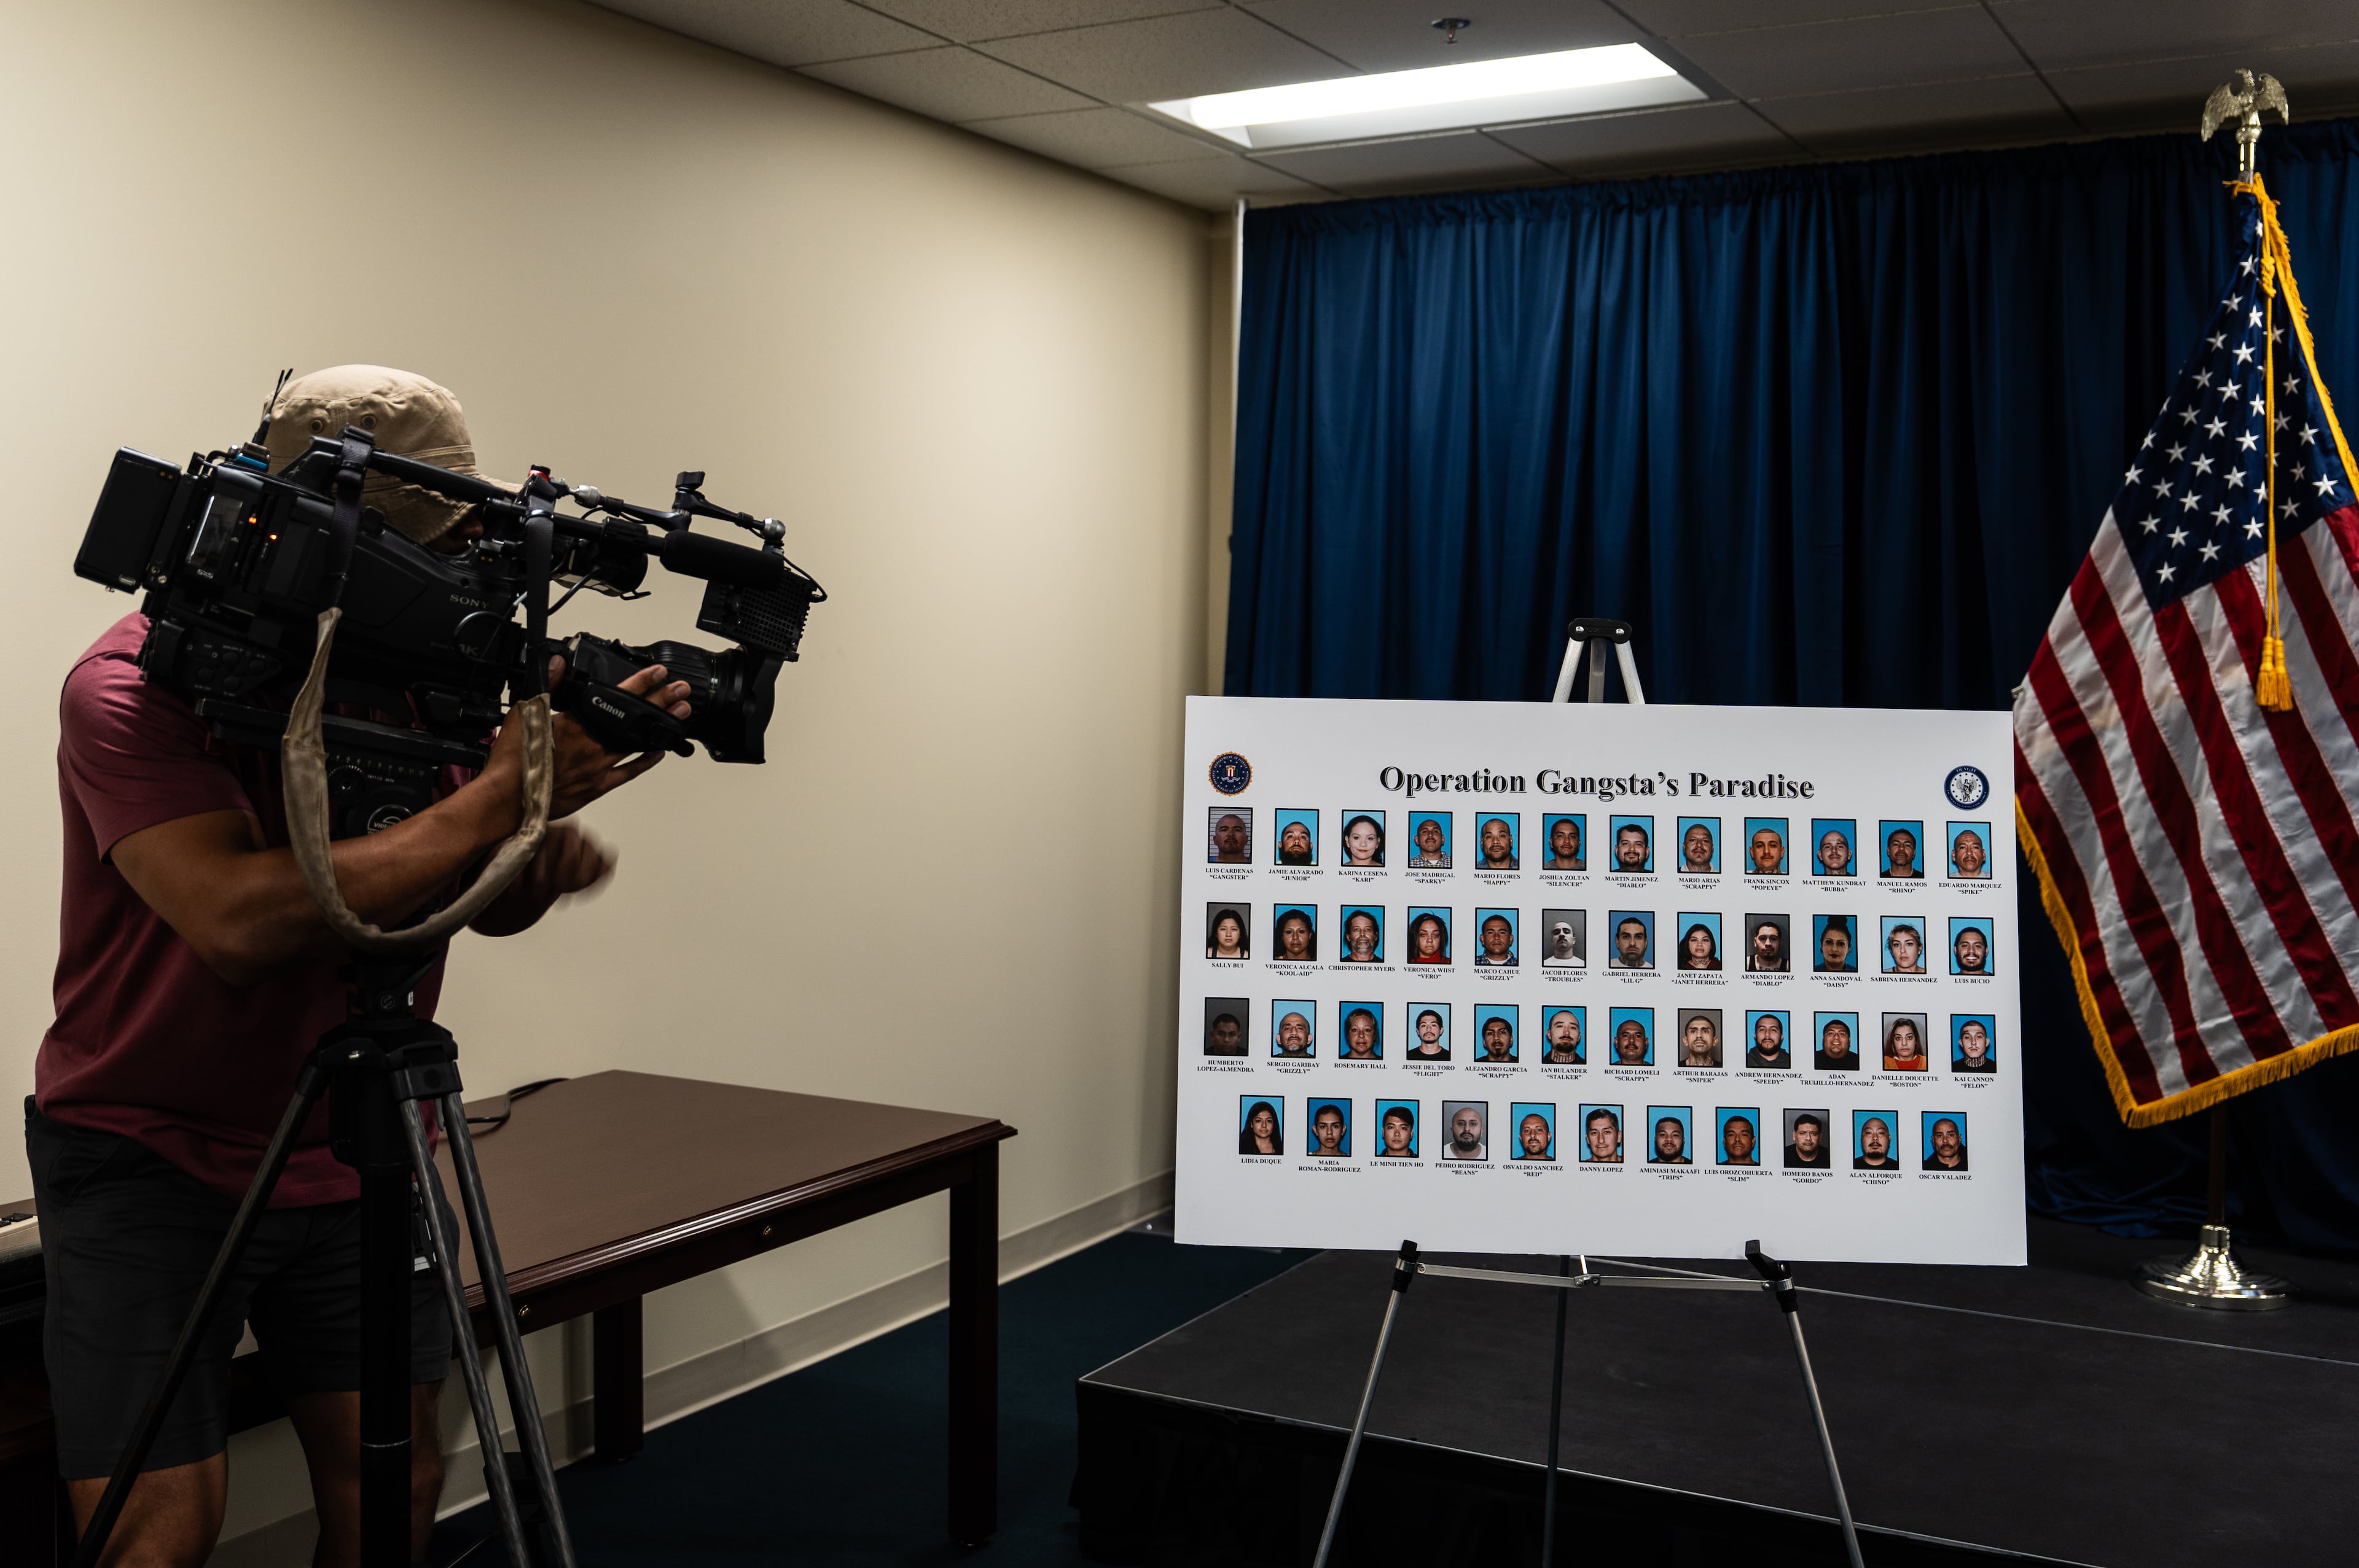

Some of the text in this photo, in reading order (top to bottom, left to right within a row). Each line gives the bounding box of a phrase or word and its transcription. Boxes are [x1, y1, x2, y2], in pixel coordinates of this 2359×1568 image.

[449, 593, 490, 609] SONY
[591, 695, 625, 719] Canon
[1380, 766, 1815, 802] Operation Gangsta’s Paradise
